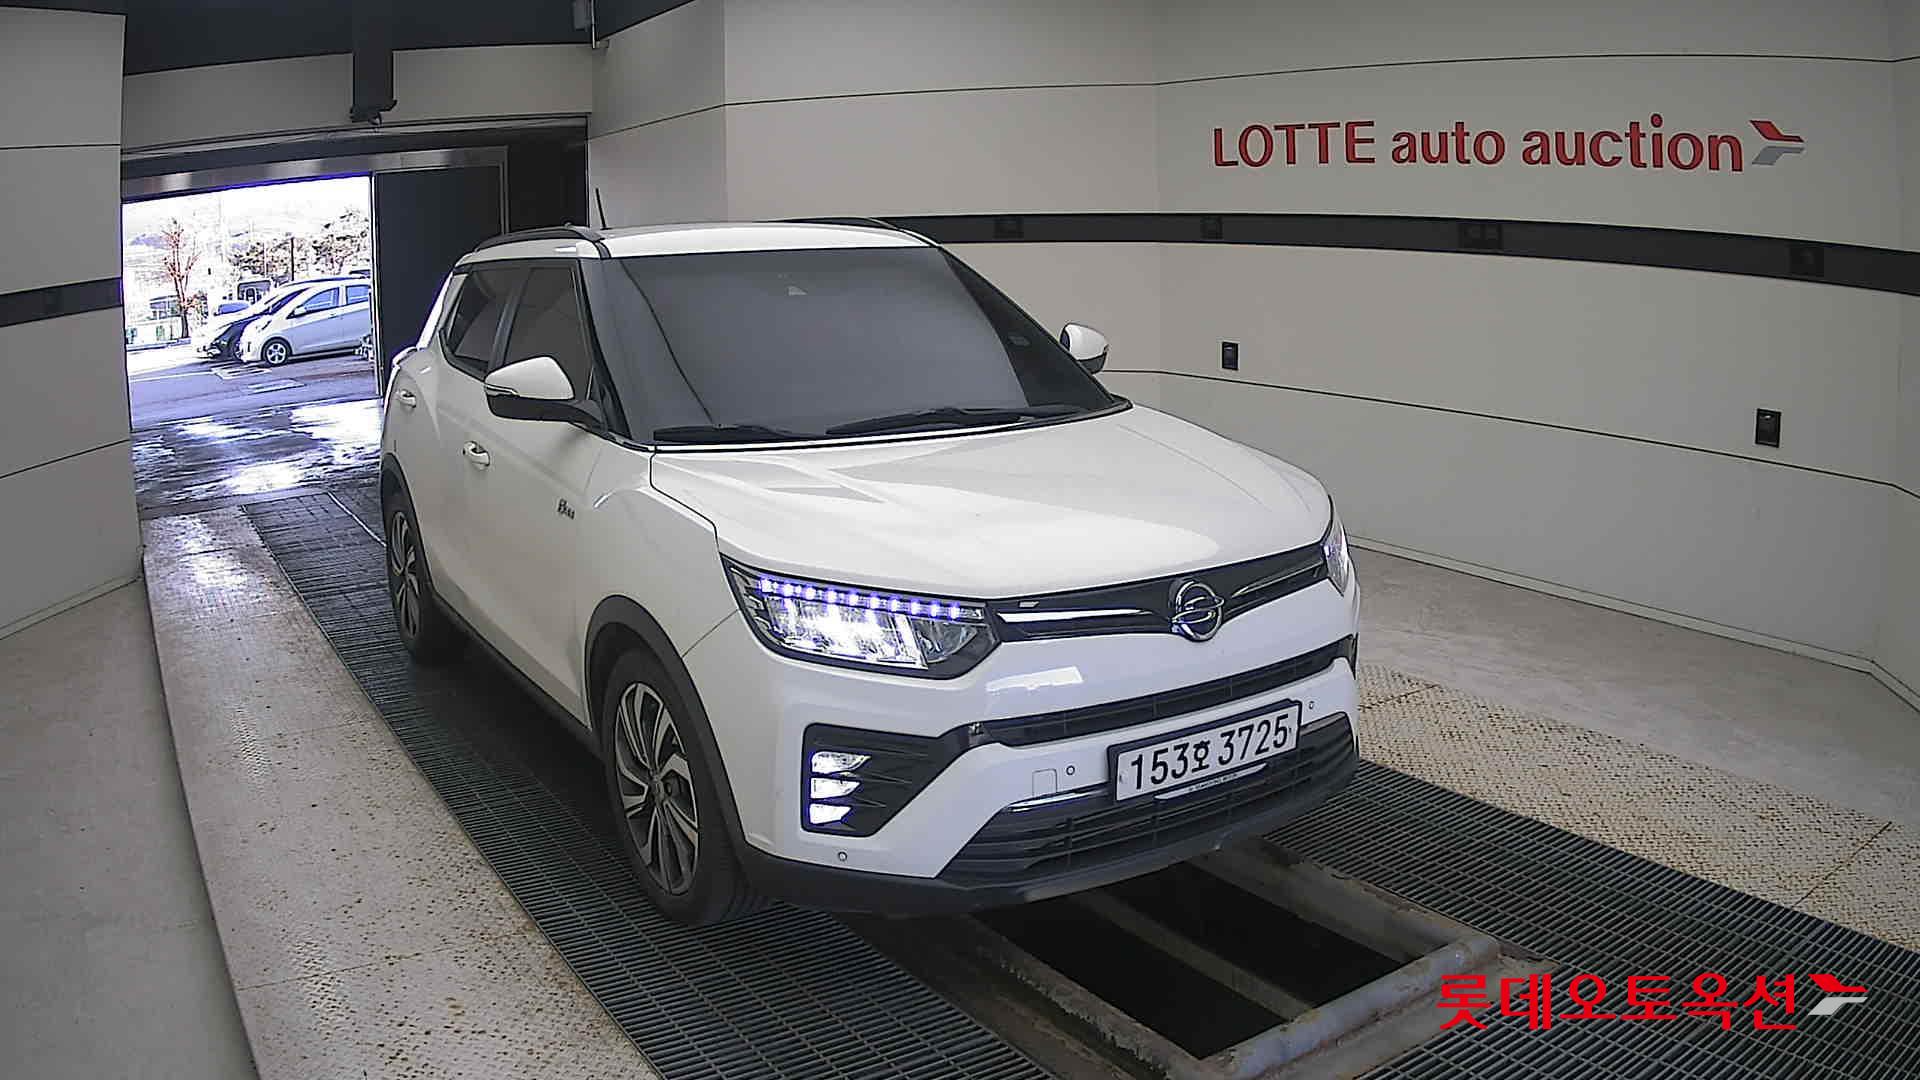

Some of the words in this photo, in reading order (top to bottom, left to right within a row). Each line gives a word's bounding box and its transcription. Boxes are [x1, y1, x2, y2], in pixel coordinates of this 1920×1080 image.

[1213, 121, 1376, 167] LOTTE
[1391, 121, 1506, 165] auto
[1522, 113, 1744, 171] auction
[1218, 713, 1289, 766] 3725
